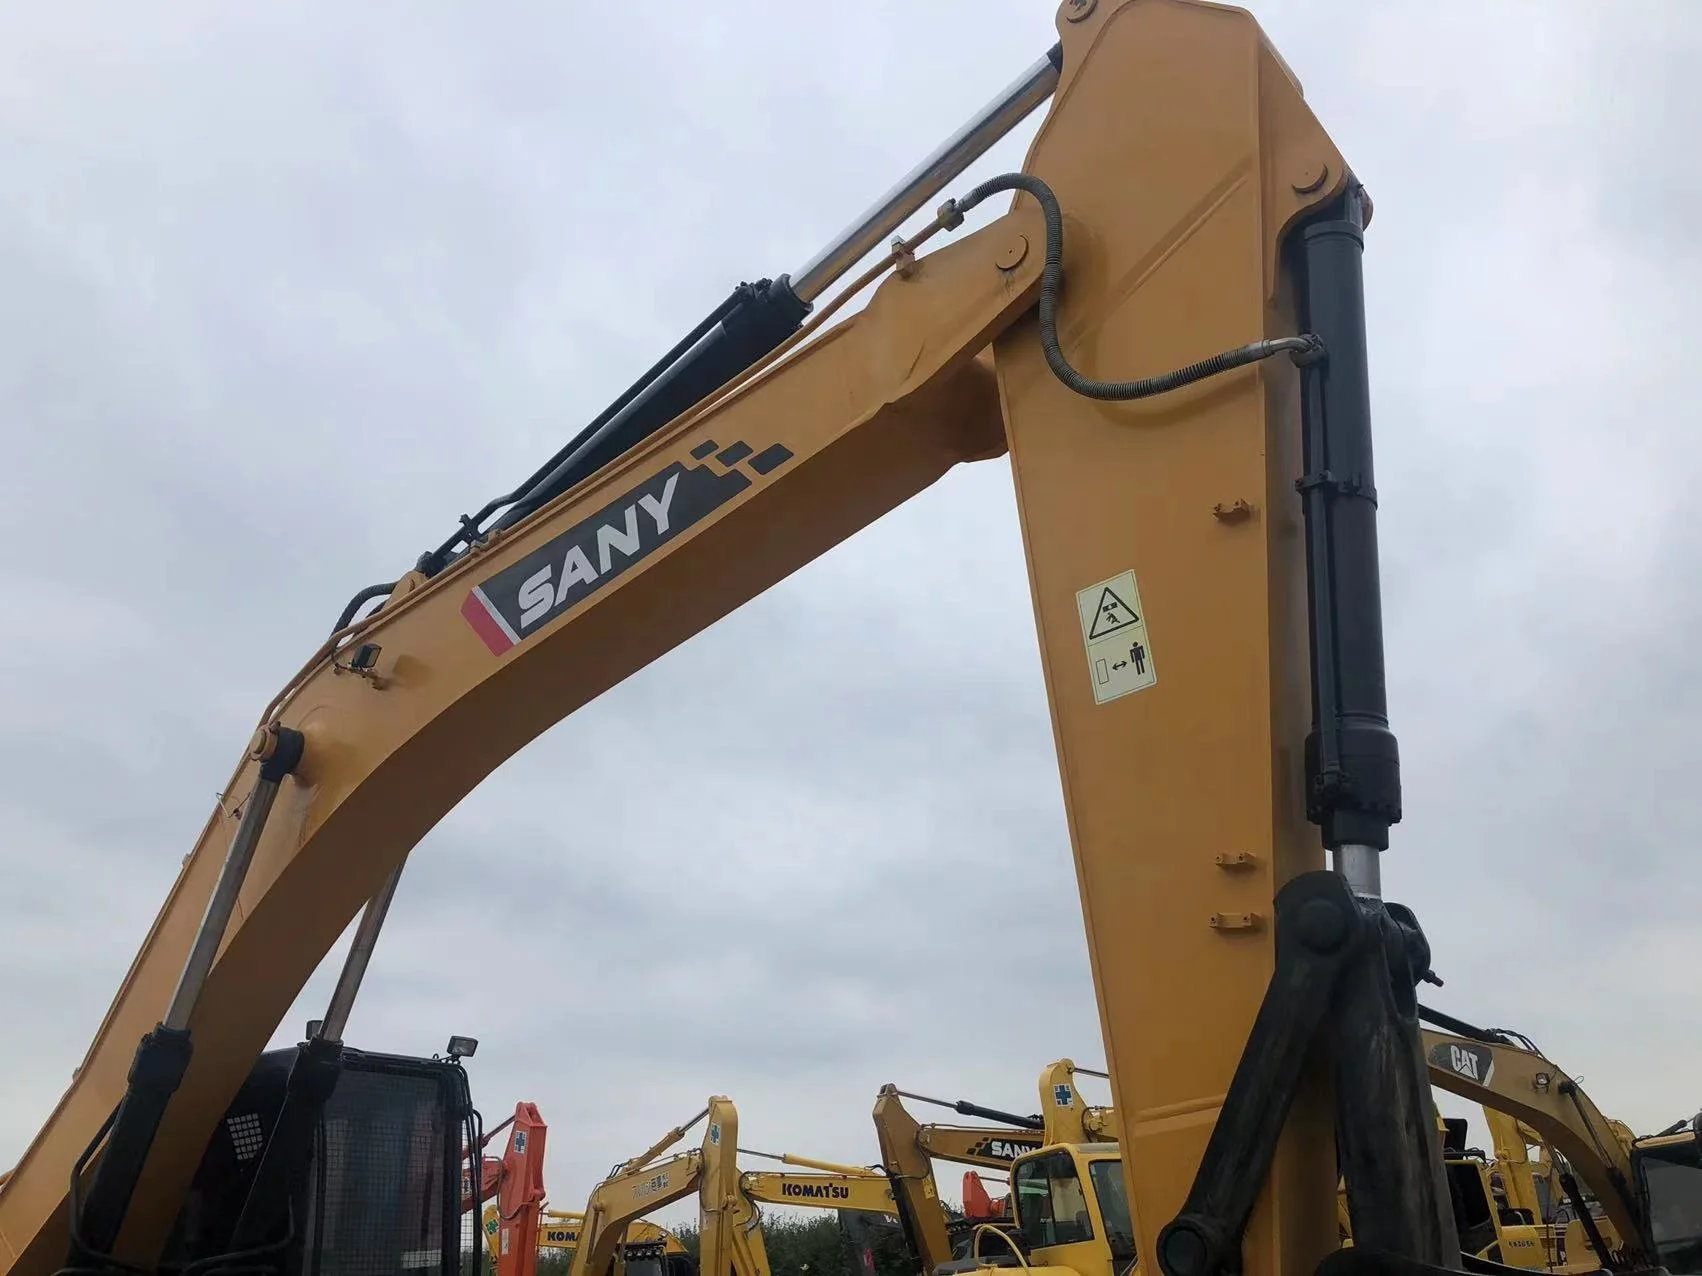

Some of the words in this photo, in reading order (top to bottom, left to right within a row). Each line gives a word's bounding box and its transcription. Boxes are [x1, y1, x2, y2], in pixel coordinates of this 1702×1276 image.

[518, 472, 679, 629] SANY
[1450, 1045, 1479, 1080] CAT
[782, 1183, 849, 1199] KOMATSU
[547, 1231, 577, 1241] KOM
